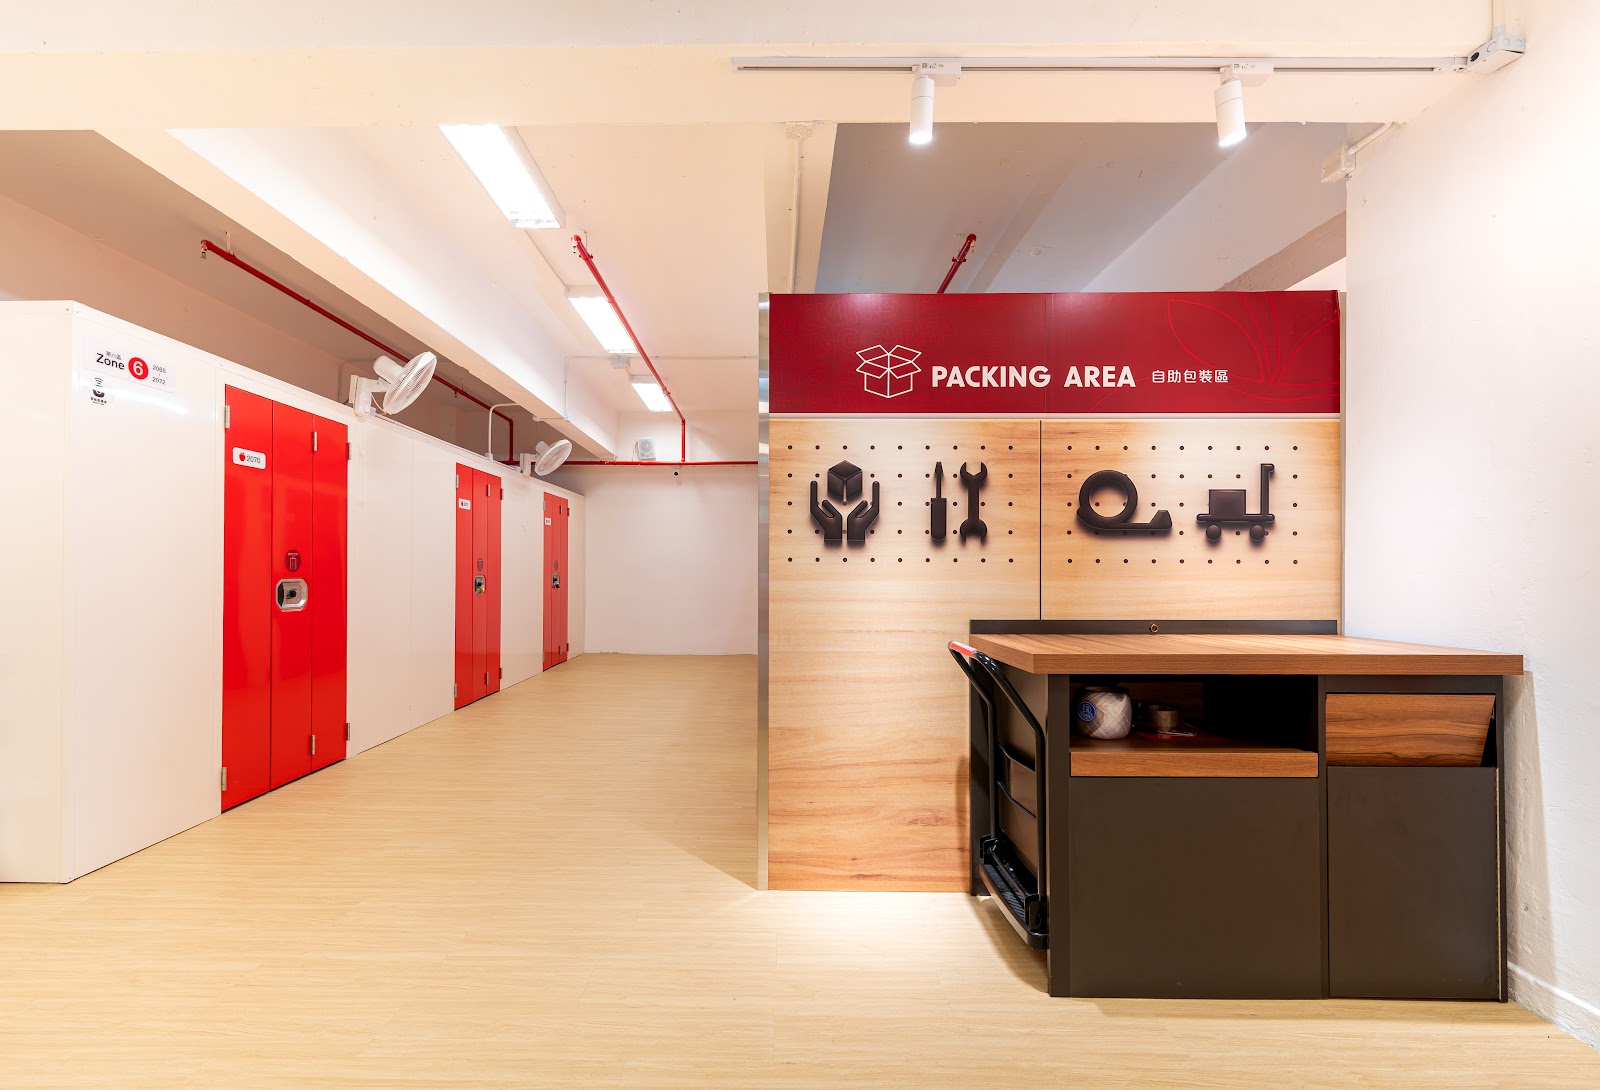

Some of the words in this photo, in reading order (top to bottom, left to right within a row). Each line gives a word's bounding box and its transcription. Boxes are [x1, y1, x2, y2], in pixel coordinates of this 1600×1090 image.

[96, 352, 125, 370] Zone
[133, 360, 143, 376] 6
[152, 377, 166, 385] 2072
[931, 365, 1051, 388] PACKING
[1063, 365, 1136, 388] AREA
[1152, 369, 1229, 383] 自助包裝區
[246, 455, 260, 463] 2070
